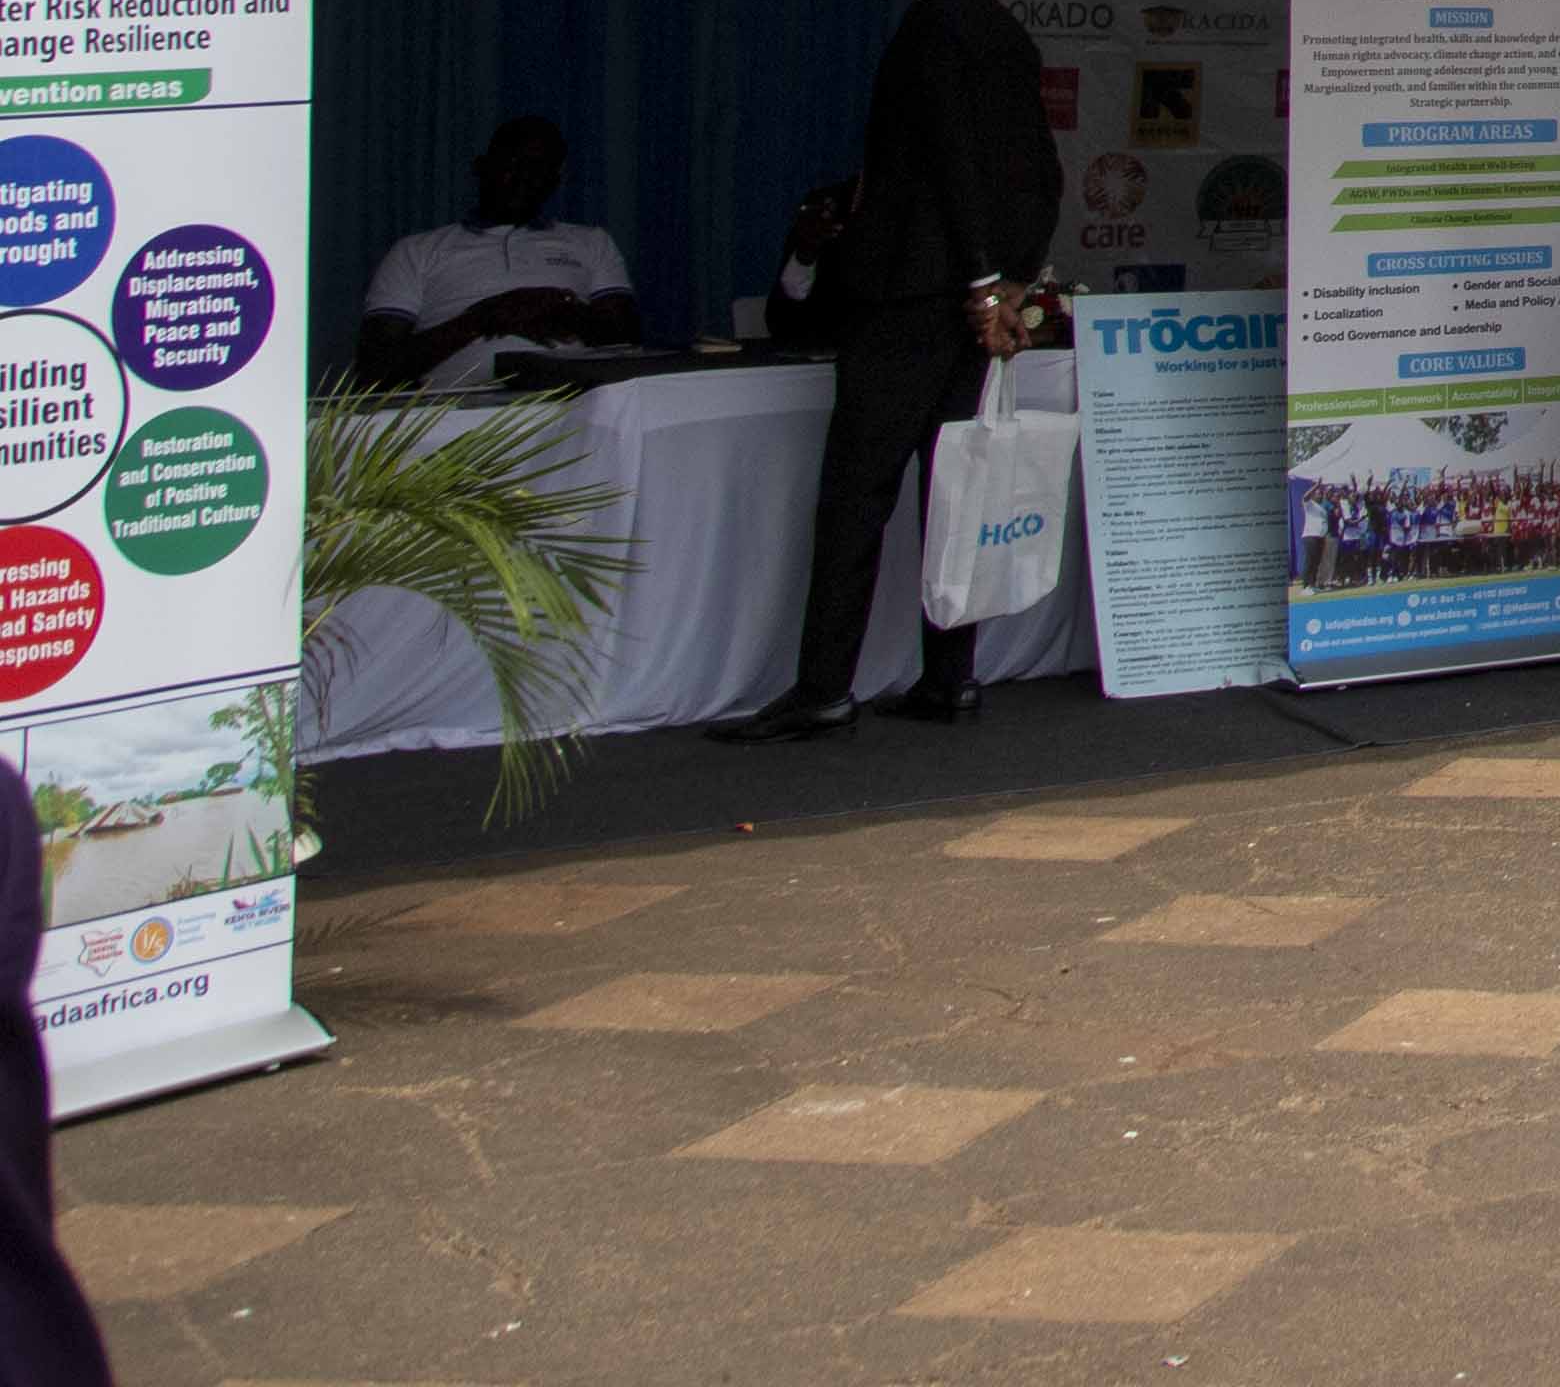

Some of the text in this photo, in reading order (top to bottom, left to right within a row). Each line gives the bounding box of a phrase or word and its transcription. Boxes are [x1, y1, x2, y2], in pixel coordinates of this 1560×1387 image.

[1435, 11, 1488, 24] MISSION
[85, 25, 212, 54] Resilience
[110, 80, 183, 101] areas
[1388, 124, 1533, 143] PROGRAM AREAS
[1081, 223, 1145, 249] care
[143, 246, 244, 272] Addressing
[1377, 251, 1543, 272] CROSS CUTTING ISSUES
[129, 269, 259, 297] Displacement,
[1313, 283, 1420, 301] Disability inclusion
[1464, 279, 1501, 292] Gender
[1504, 278, 1524, 289] and
[1527, 275, 1560, 287] Social
[146, 295, 240, 321] Migration,
[1314, 307, 1383, 321] Localization
[144, 317, 241, 345] Peace and
[1313, 321, 1501, 343] Good Governance and Leadership
[153, 343, 231, 369] Security
[1156, 360, 1216, 373] Working
[1218, 359, 1238, 370] for
[1250, 358, 1277, 371] just
[1410, 353, 1515, 373] CORE VALUES
[142, 432, 233, 458] Restoration
[120, 454, 256, 487] and Conservation
[145, 483, 227, 508] of Positive
[113, 503, 260, 539] Traditional Culture
[11, 580, 90, 609] Hazards
[32, 606, 96, 634] Safety
